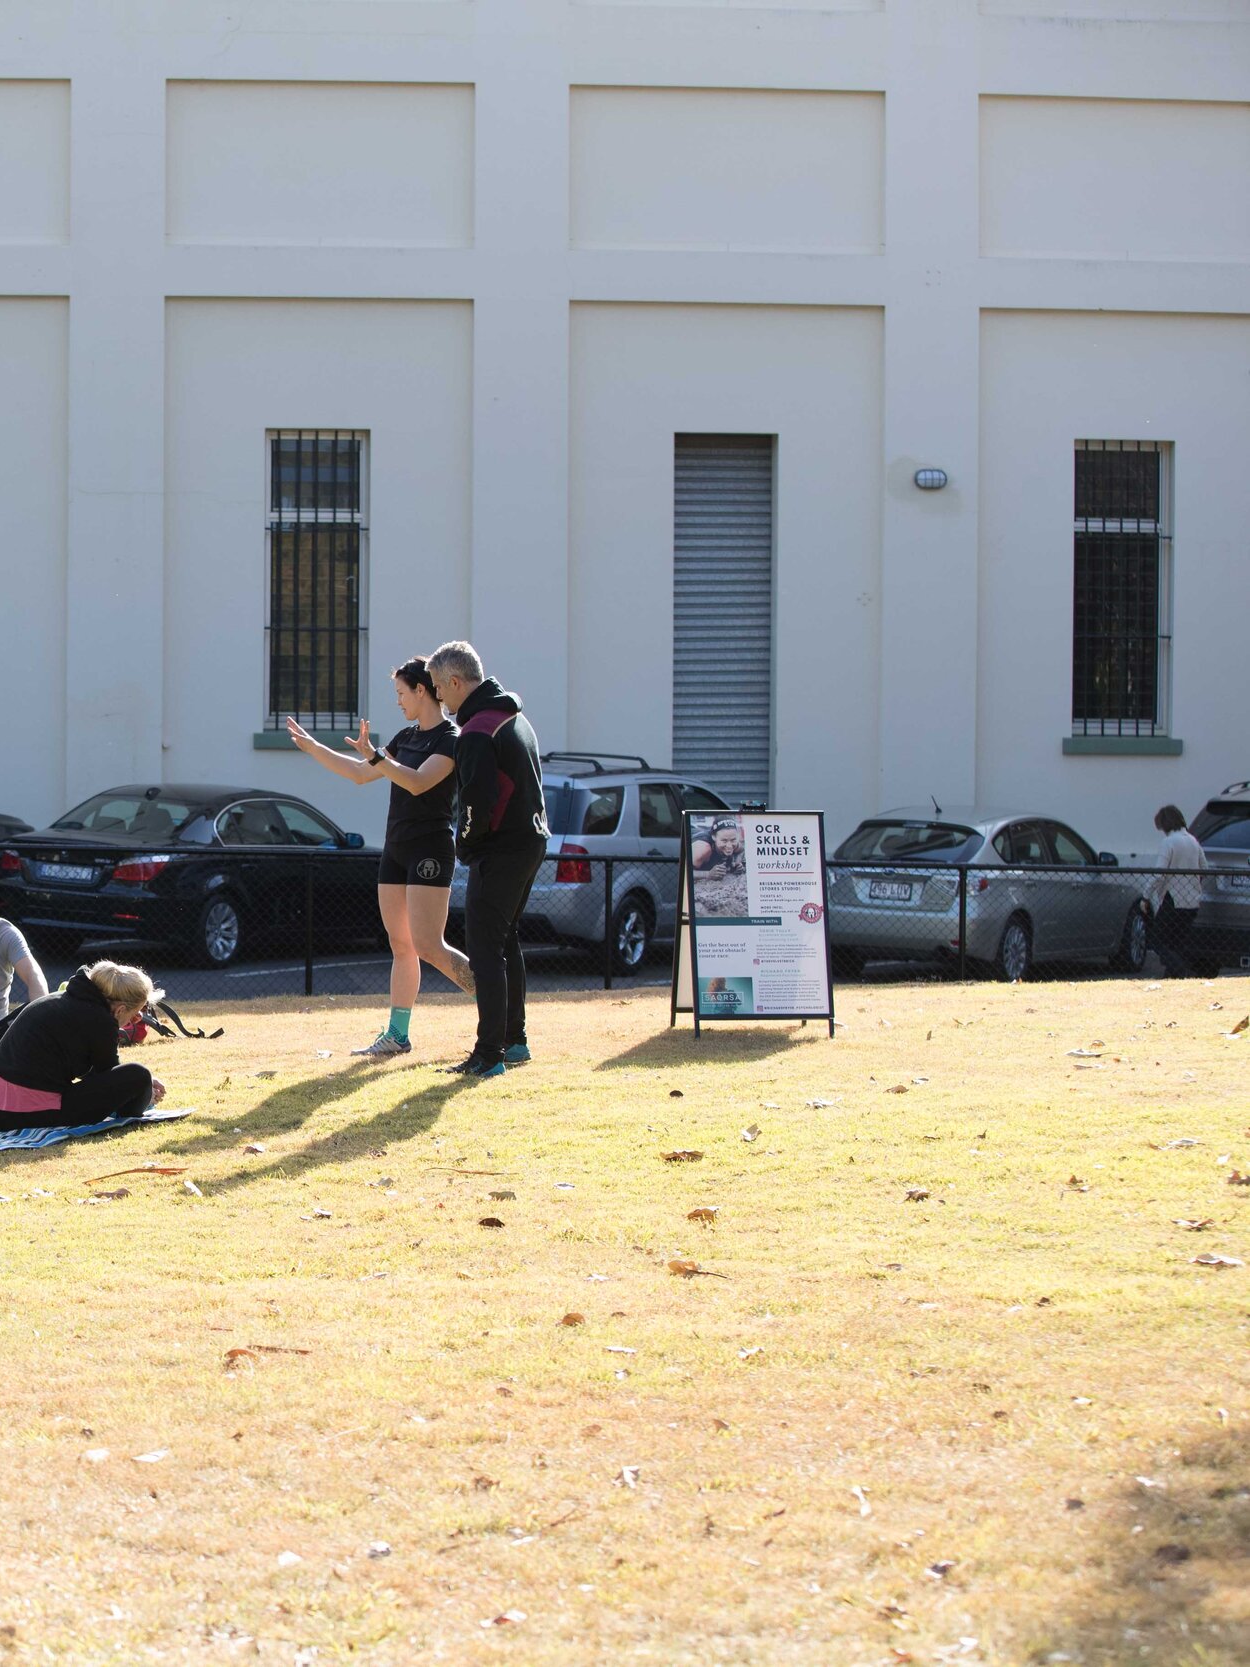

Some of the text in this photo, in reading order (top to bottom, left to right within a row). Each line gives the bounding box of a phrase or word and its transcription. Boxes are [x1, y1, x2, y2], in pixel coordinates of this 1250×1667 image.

[755, 824, 780, 833] OCR
[756, 835, 810, 845] SKILLS &
[756, 847, 809, 856] MINDSET
[757, 860, 802, 871] workshop
